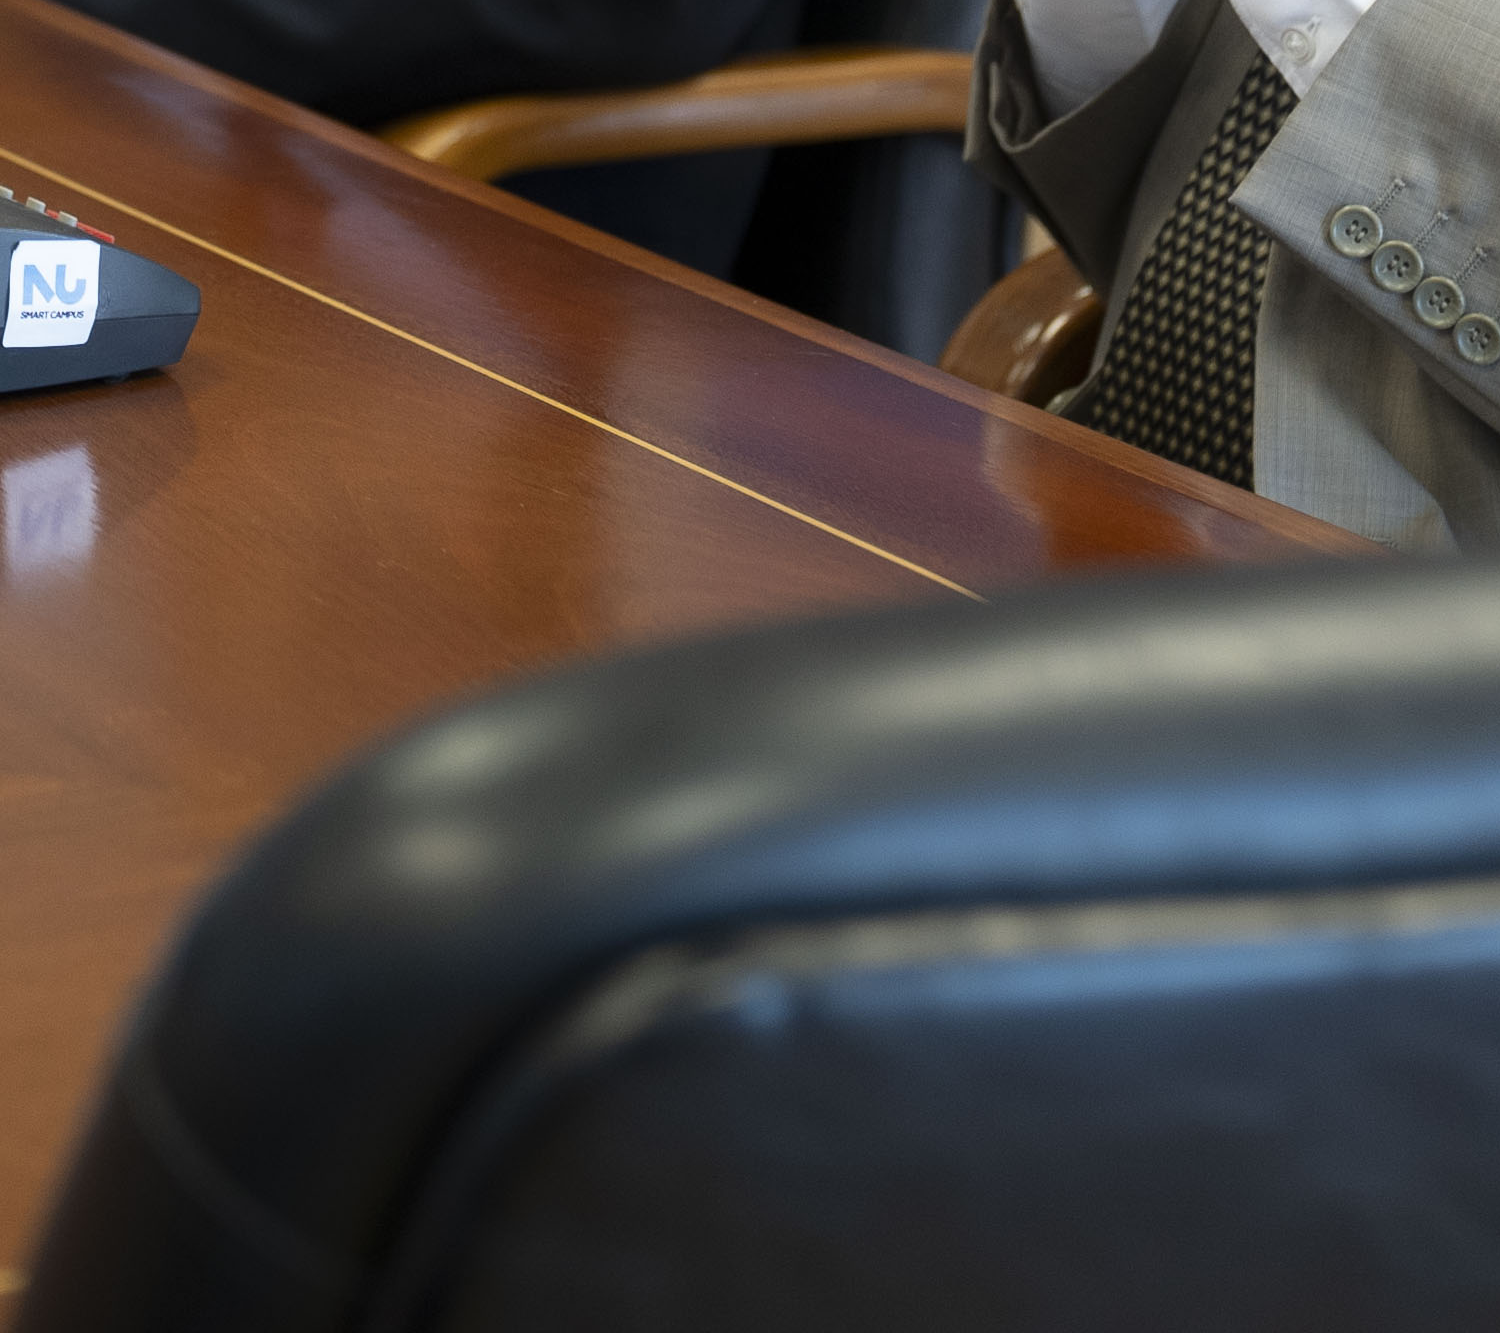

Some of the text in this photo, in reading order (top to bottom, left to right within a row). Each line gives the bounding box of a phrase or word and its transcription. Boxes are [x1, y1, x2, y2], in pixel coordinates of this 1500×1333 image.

[22, 264, 87, 305] NU
[19, 310, 85, 319] SMART CAMPUS
